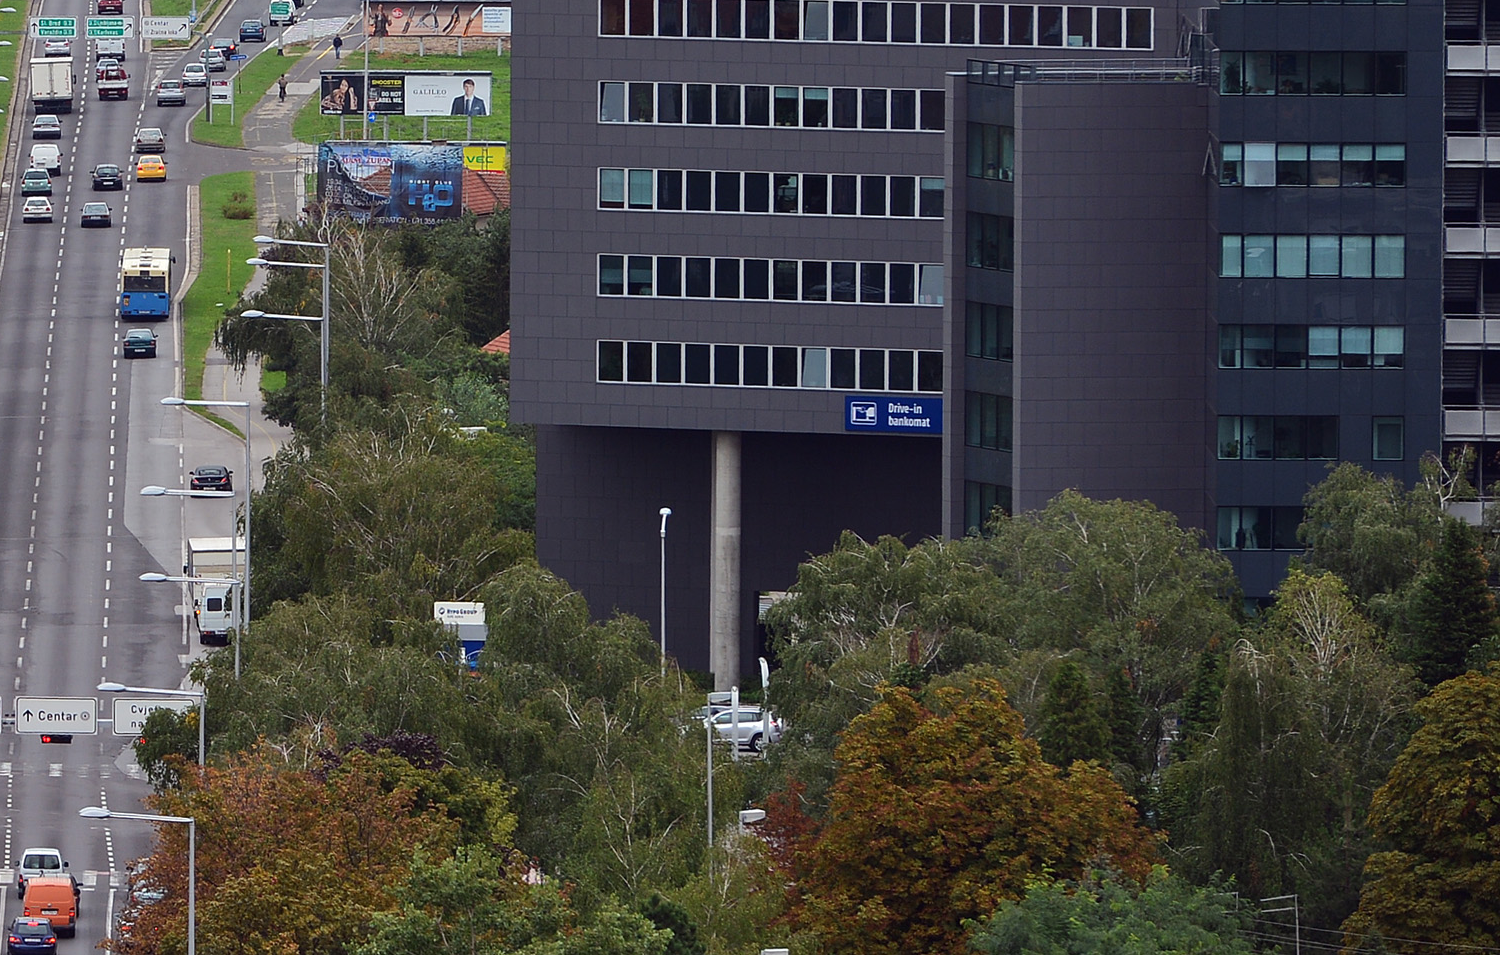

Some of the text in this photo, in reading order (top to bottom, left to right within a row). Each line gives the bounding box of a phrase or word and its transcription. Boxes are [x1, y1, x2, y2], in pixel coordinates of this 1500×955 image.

[888, 403, 923, 414] Drive-in
[888, 416, 931, 428] bankomat
[38, 710, 78, 721] Centar
